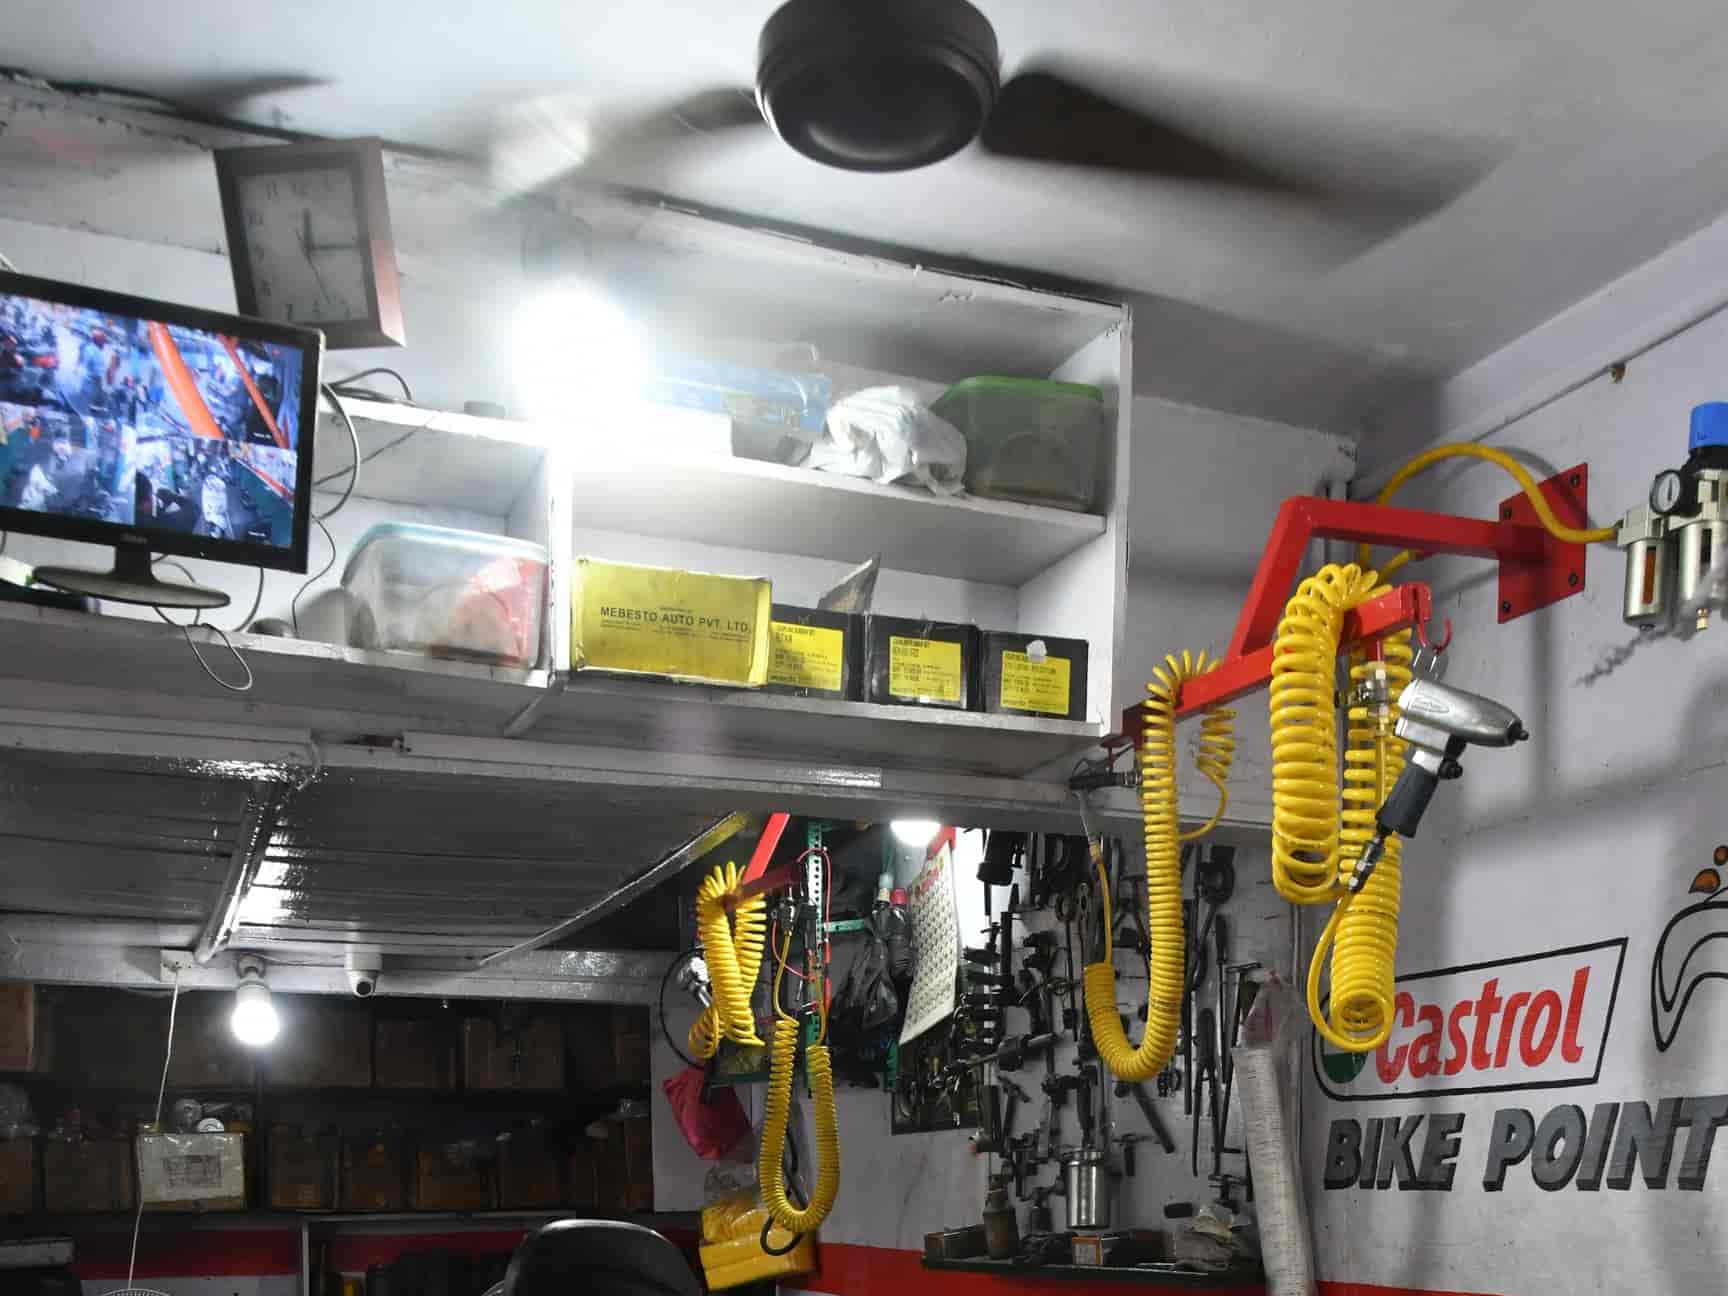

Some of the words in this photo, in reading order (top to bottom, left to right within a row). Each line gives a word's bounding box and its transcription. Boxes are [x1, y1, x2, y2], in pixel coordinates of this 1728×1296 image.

[600, 606, 658, 622] MEBESTO
[662, 613, 694, 626] AUTO
[1374, 965, 1592, 1083] Castrol
[1323, 1112, 1466, 1191] BIKE
[1482, 1095, 1728, 1191] POINT
